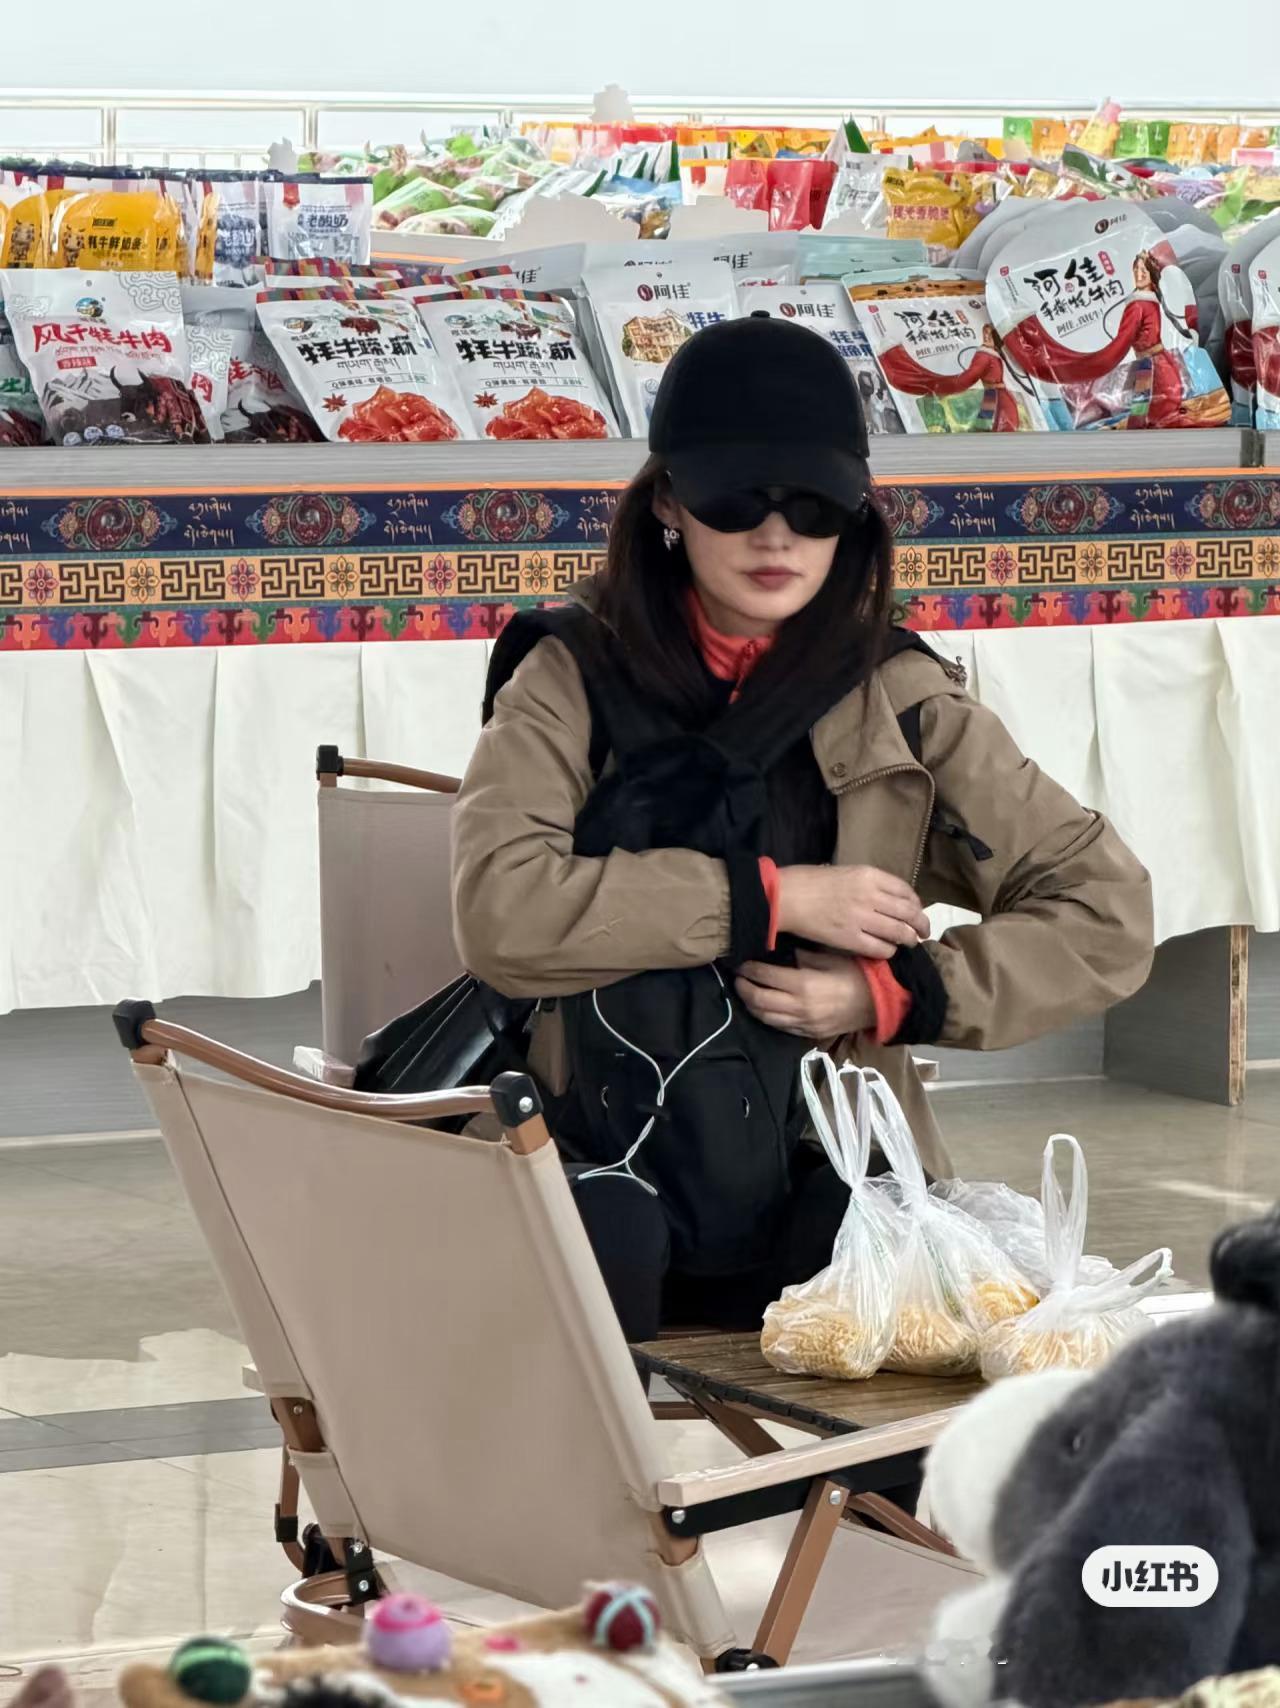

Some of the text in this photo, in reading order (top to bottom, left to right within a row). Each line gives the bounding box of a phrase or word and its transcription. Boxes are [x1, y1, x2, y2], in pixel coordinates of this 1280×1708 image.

[653, 283, 689, 300] 阿佳
[796, 303, 835, 319] 阿佳
[32, 322, 172, 353] 风干牦牛肉
